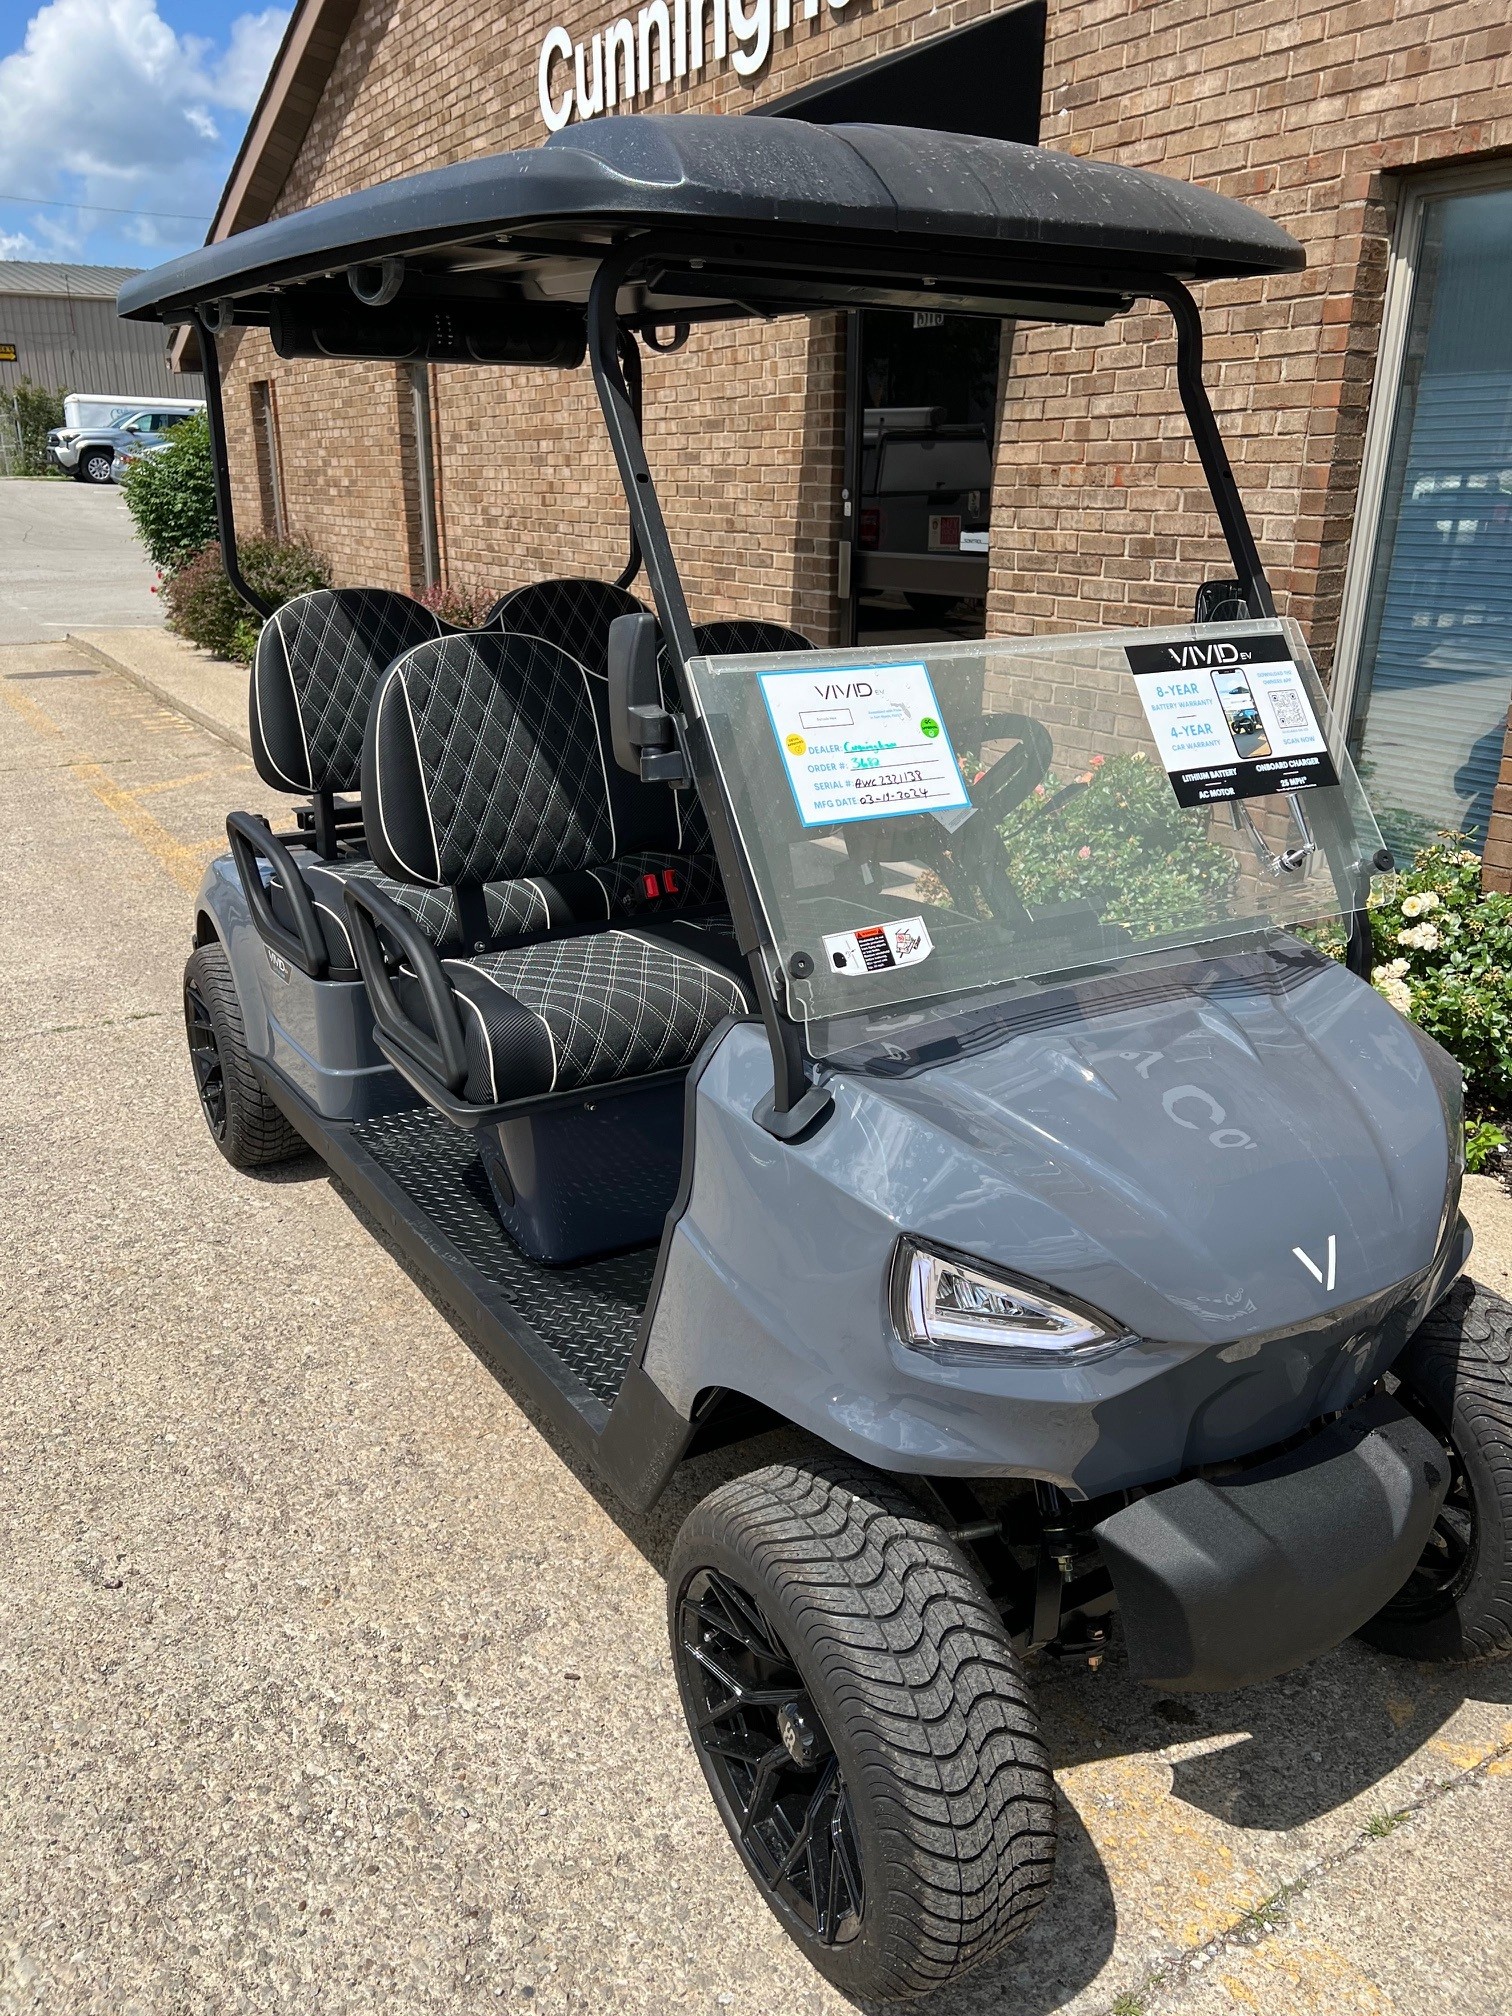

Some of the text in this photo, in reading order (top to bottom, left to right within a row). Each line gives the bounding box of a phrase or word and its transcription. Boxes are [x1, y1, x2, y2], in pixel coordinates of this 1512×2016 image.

[538, 0, 856, 132] Cunning
[1168, 643, 1252, 667] VIVID EV
[814, 683, 873, 700] VIVID
[1156, 682, 1199, 698] 8-YEAR
[1151, 698, 1213, 712] BATTERY WARRANTY
[1170, 723, 1213, 739] 4-YEAR
[1171, 738, 1221, 752] CAR WARRANTY
[1283, 735, 1316, 746] SCAN NOW
[808, 745, 843, 755] DEALER:
[807, 762, 837, 773] ORDER
[1255, 757, 1320, 773] ONBOARD CHARGER
[1182, 768, 1238, 783] LITHIUM BATTERY
[1280, 778, 1289, 787] 25
[813, 780, 844, 791] SERIAL
[1198, 787, 1235, 800] AC MOTOR
[813, 801, 834, 810] MFG
